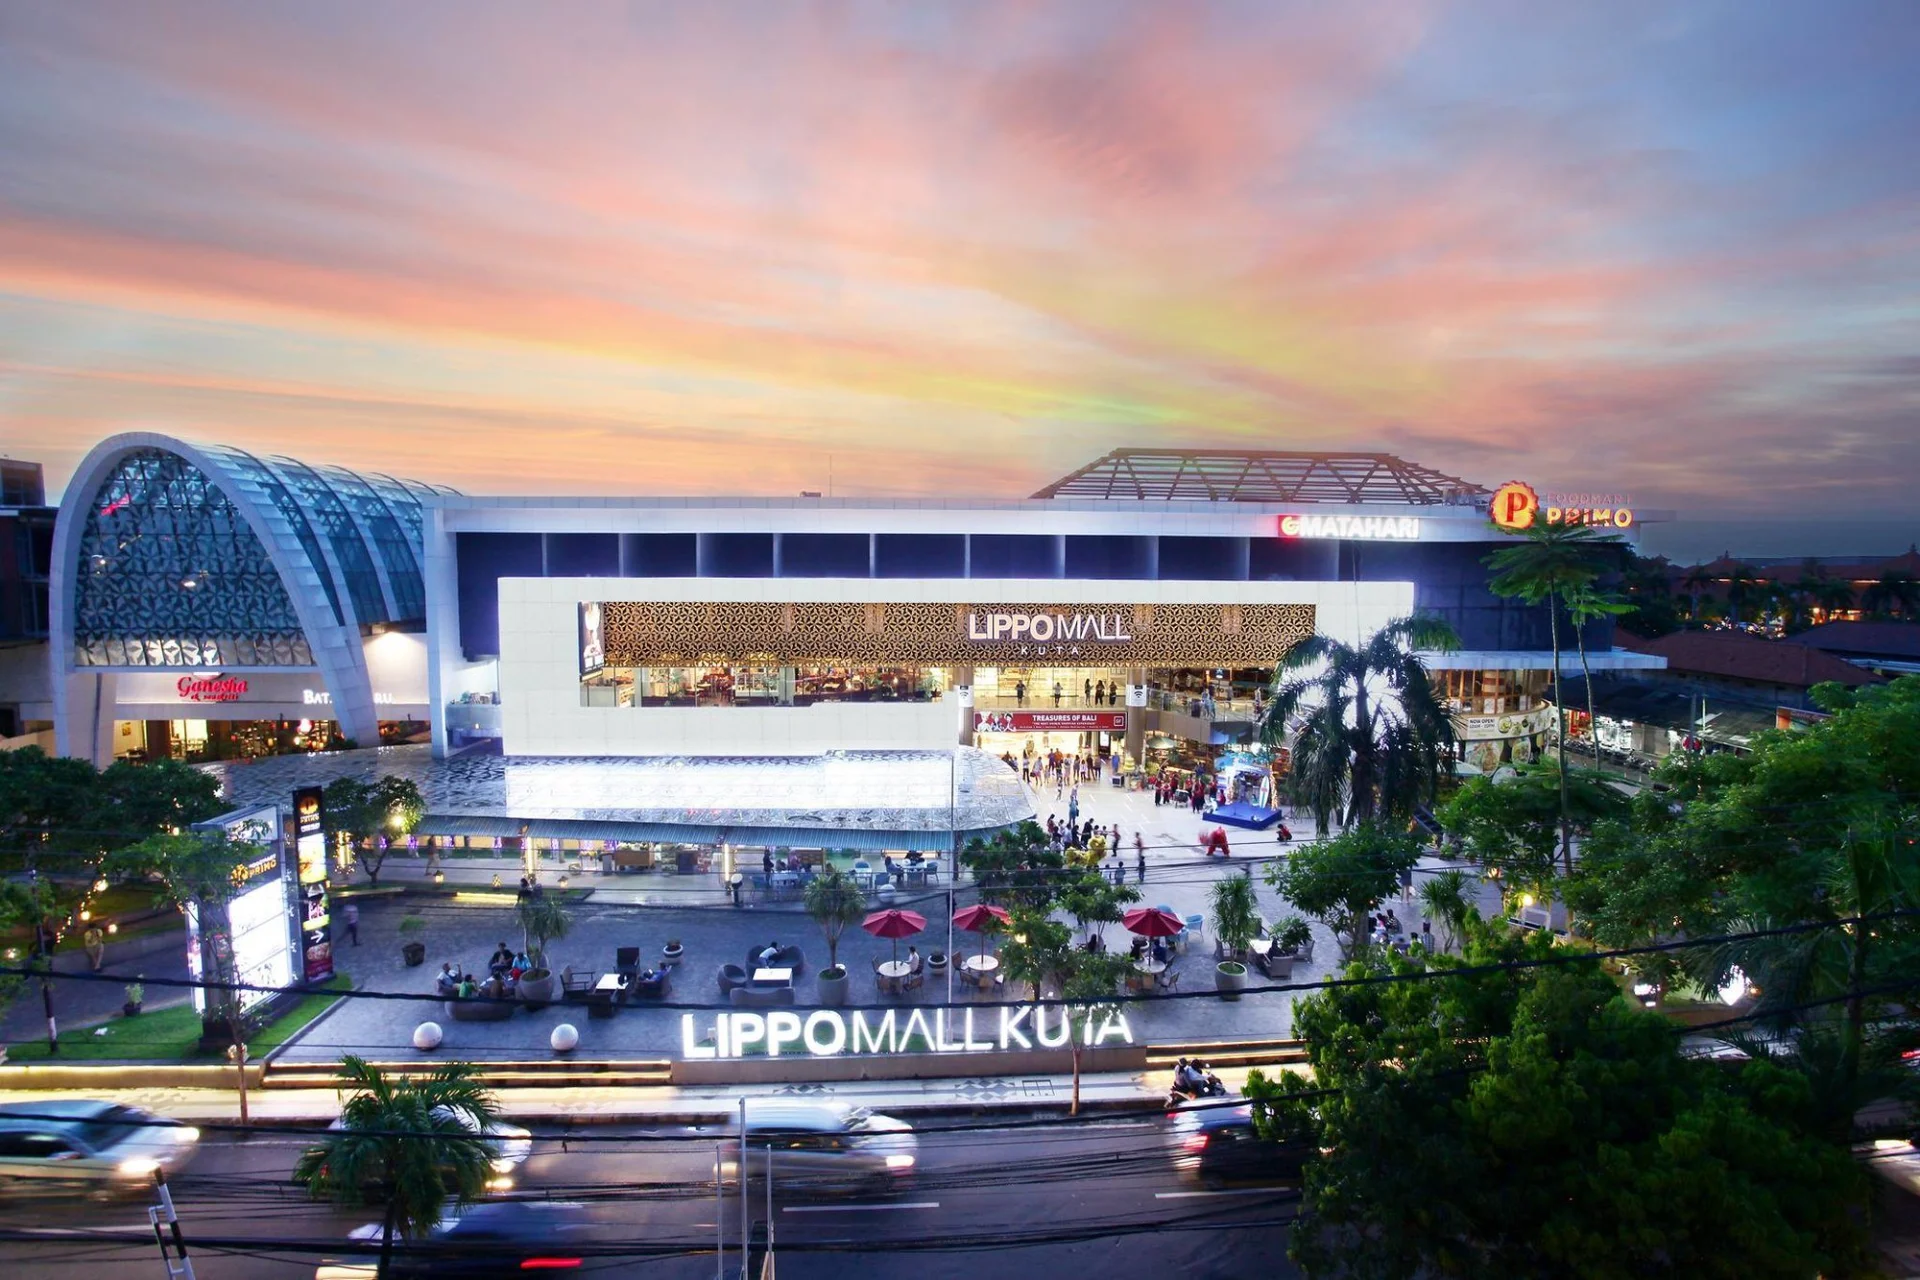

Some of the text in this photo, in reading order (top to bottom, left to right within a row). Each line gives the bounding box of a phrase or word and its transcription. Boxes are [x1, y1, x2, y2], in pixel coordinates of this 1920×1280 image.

[1547, 493, 1633, 506] FOODMART
[1546, 507, 1633, 528] PRIMO
[1300, 516, 1420, 539] MATAHARI
[1021, 646, 1079, 656] KUTA
[177, 676, 249, 697] Ganesha
[1032, 714, 1097, 722] TREASURES OF BALI
